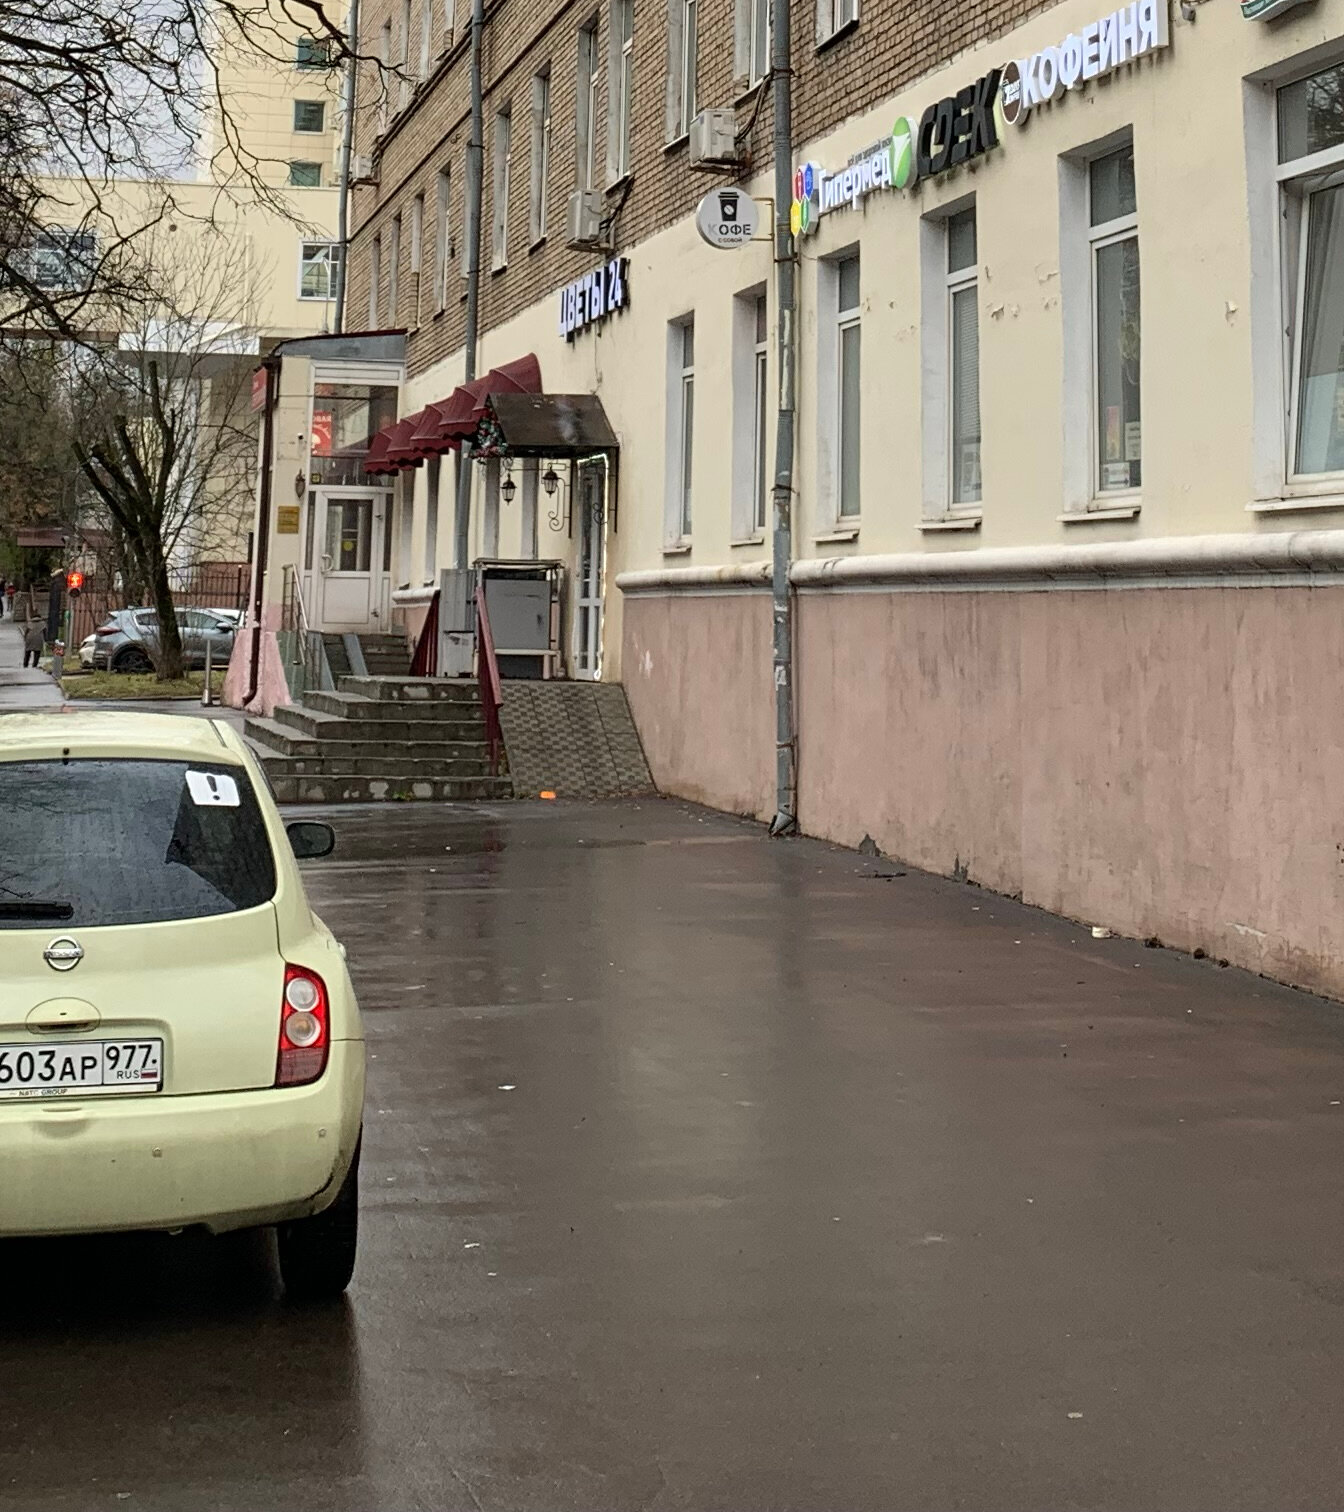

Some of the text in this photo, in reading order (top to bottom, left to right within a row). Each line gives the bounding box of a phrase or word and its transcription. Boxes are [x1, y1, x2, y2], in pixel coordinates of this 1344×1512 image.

[818, 146, 893, 213] Гипермед
[707, 223, 752, 236] КОФЕ
[559, 257, 623, 343] ЦВЕТЫ 24
[105, 1044, 154, 1070] 977
[116, 1070, 140, 1080] RUS
